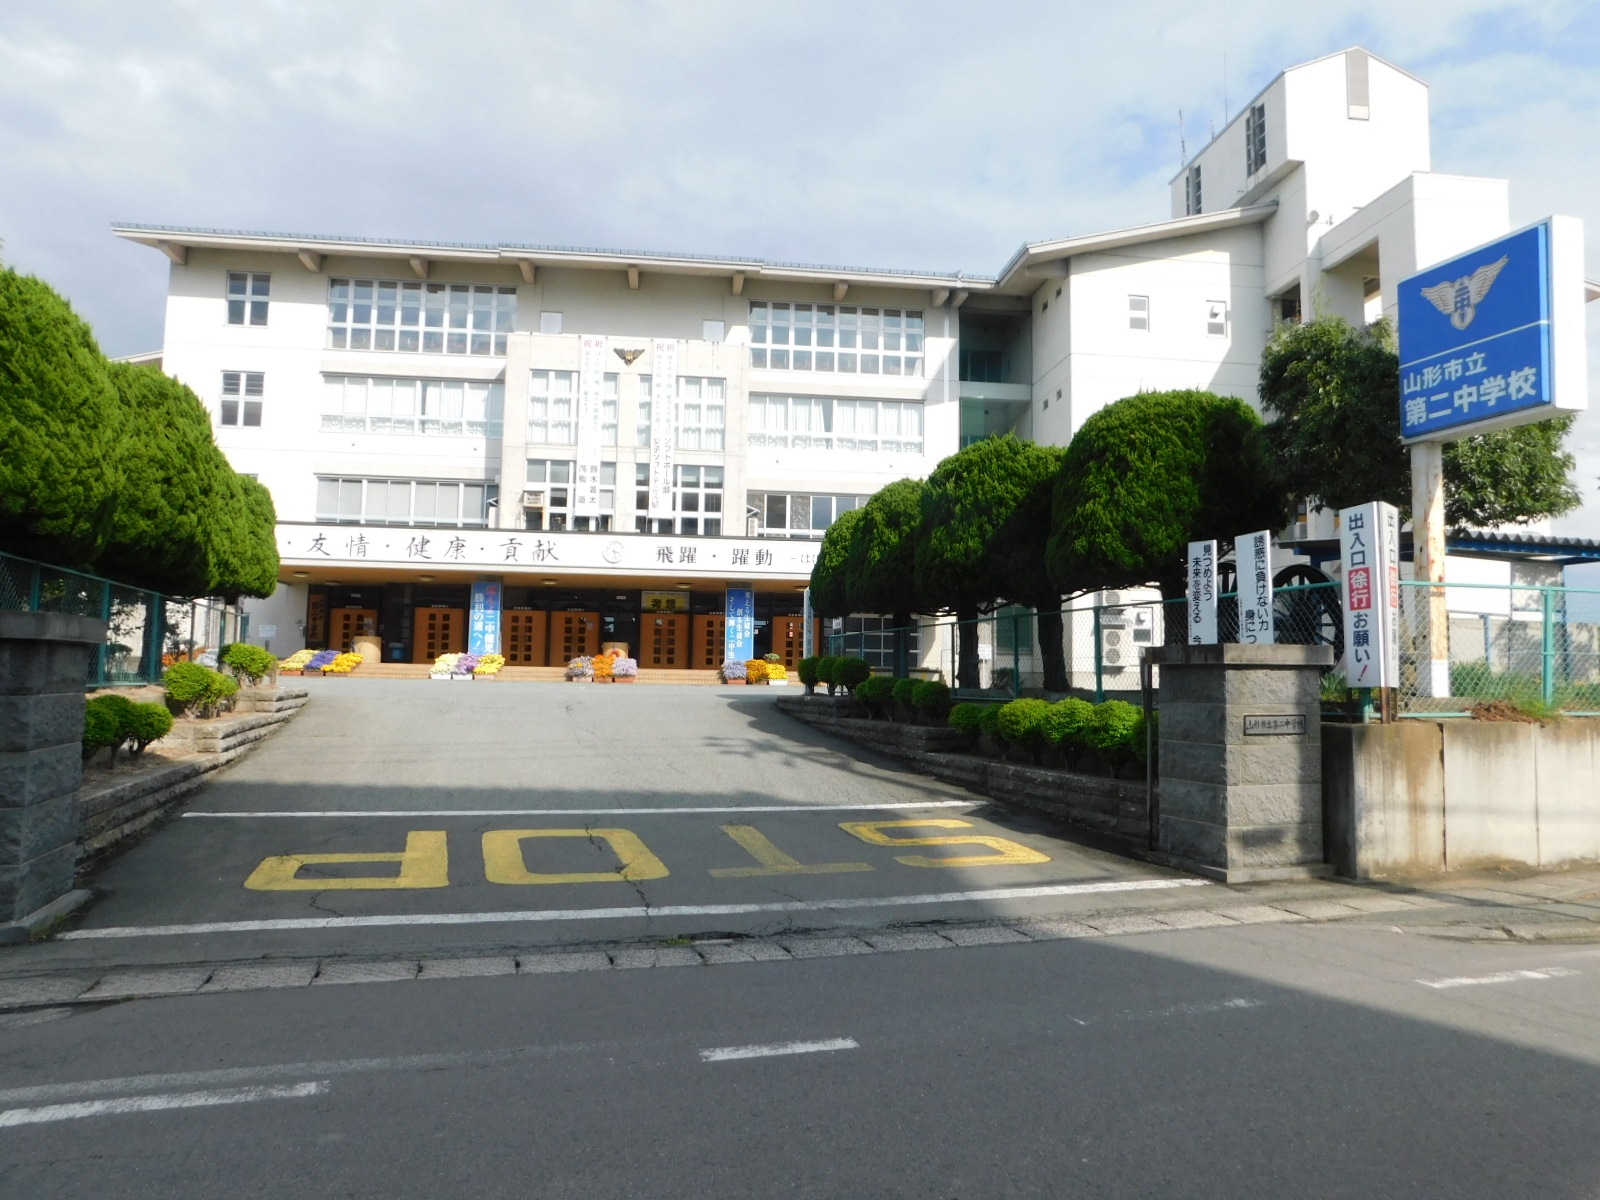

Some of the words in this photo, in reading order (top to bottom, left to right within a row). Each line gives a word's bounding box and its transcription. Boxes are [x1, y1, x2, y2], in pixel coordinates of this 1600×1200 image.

[1403, 352, 1487, 395] 山形市立
[1405, 366, 1537, 427] 第二中学校
[656, 546, 773, 567] 飛躍・躍動
[1203, 544, 1212, 601] 見つめよう
[1254, 535, 1269, 632] 誘惑に負けない力
[743, 592, 751, 638] 考える生徒会
[1193, 557, 1201, 624] 未来を変える
[244, 818, 1051, 891] STOP
